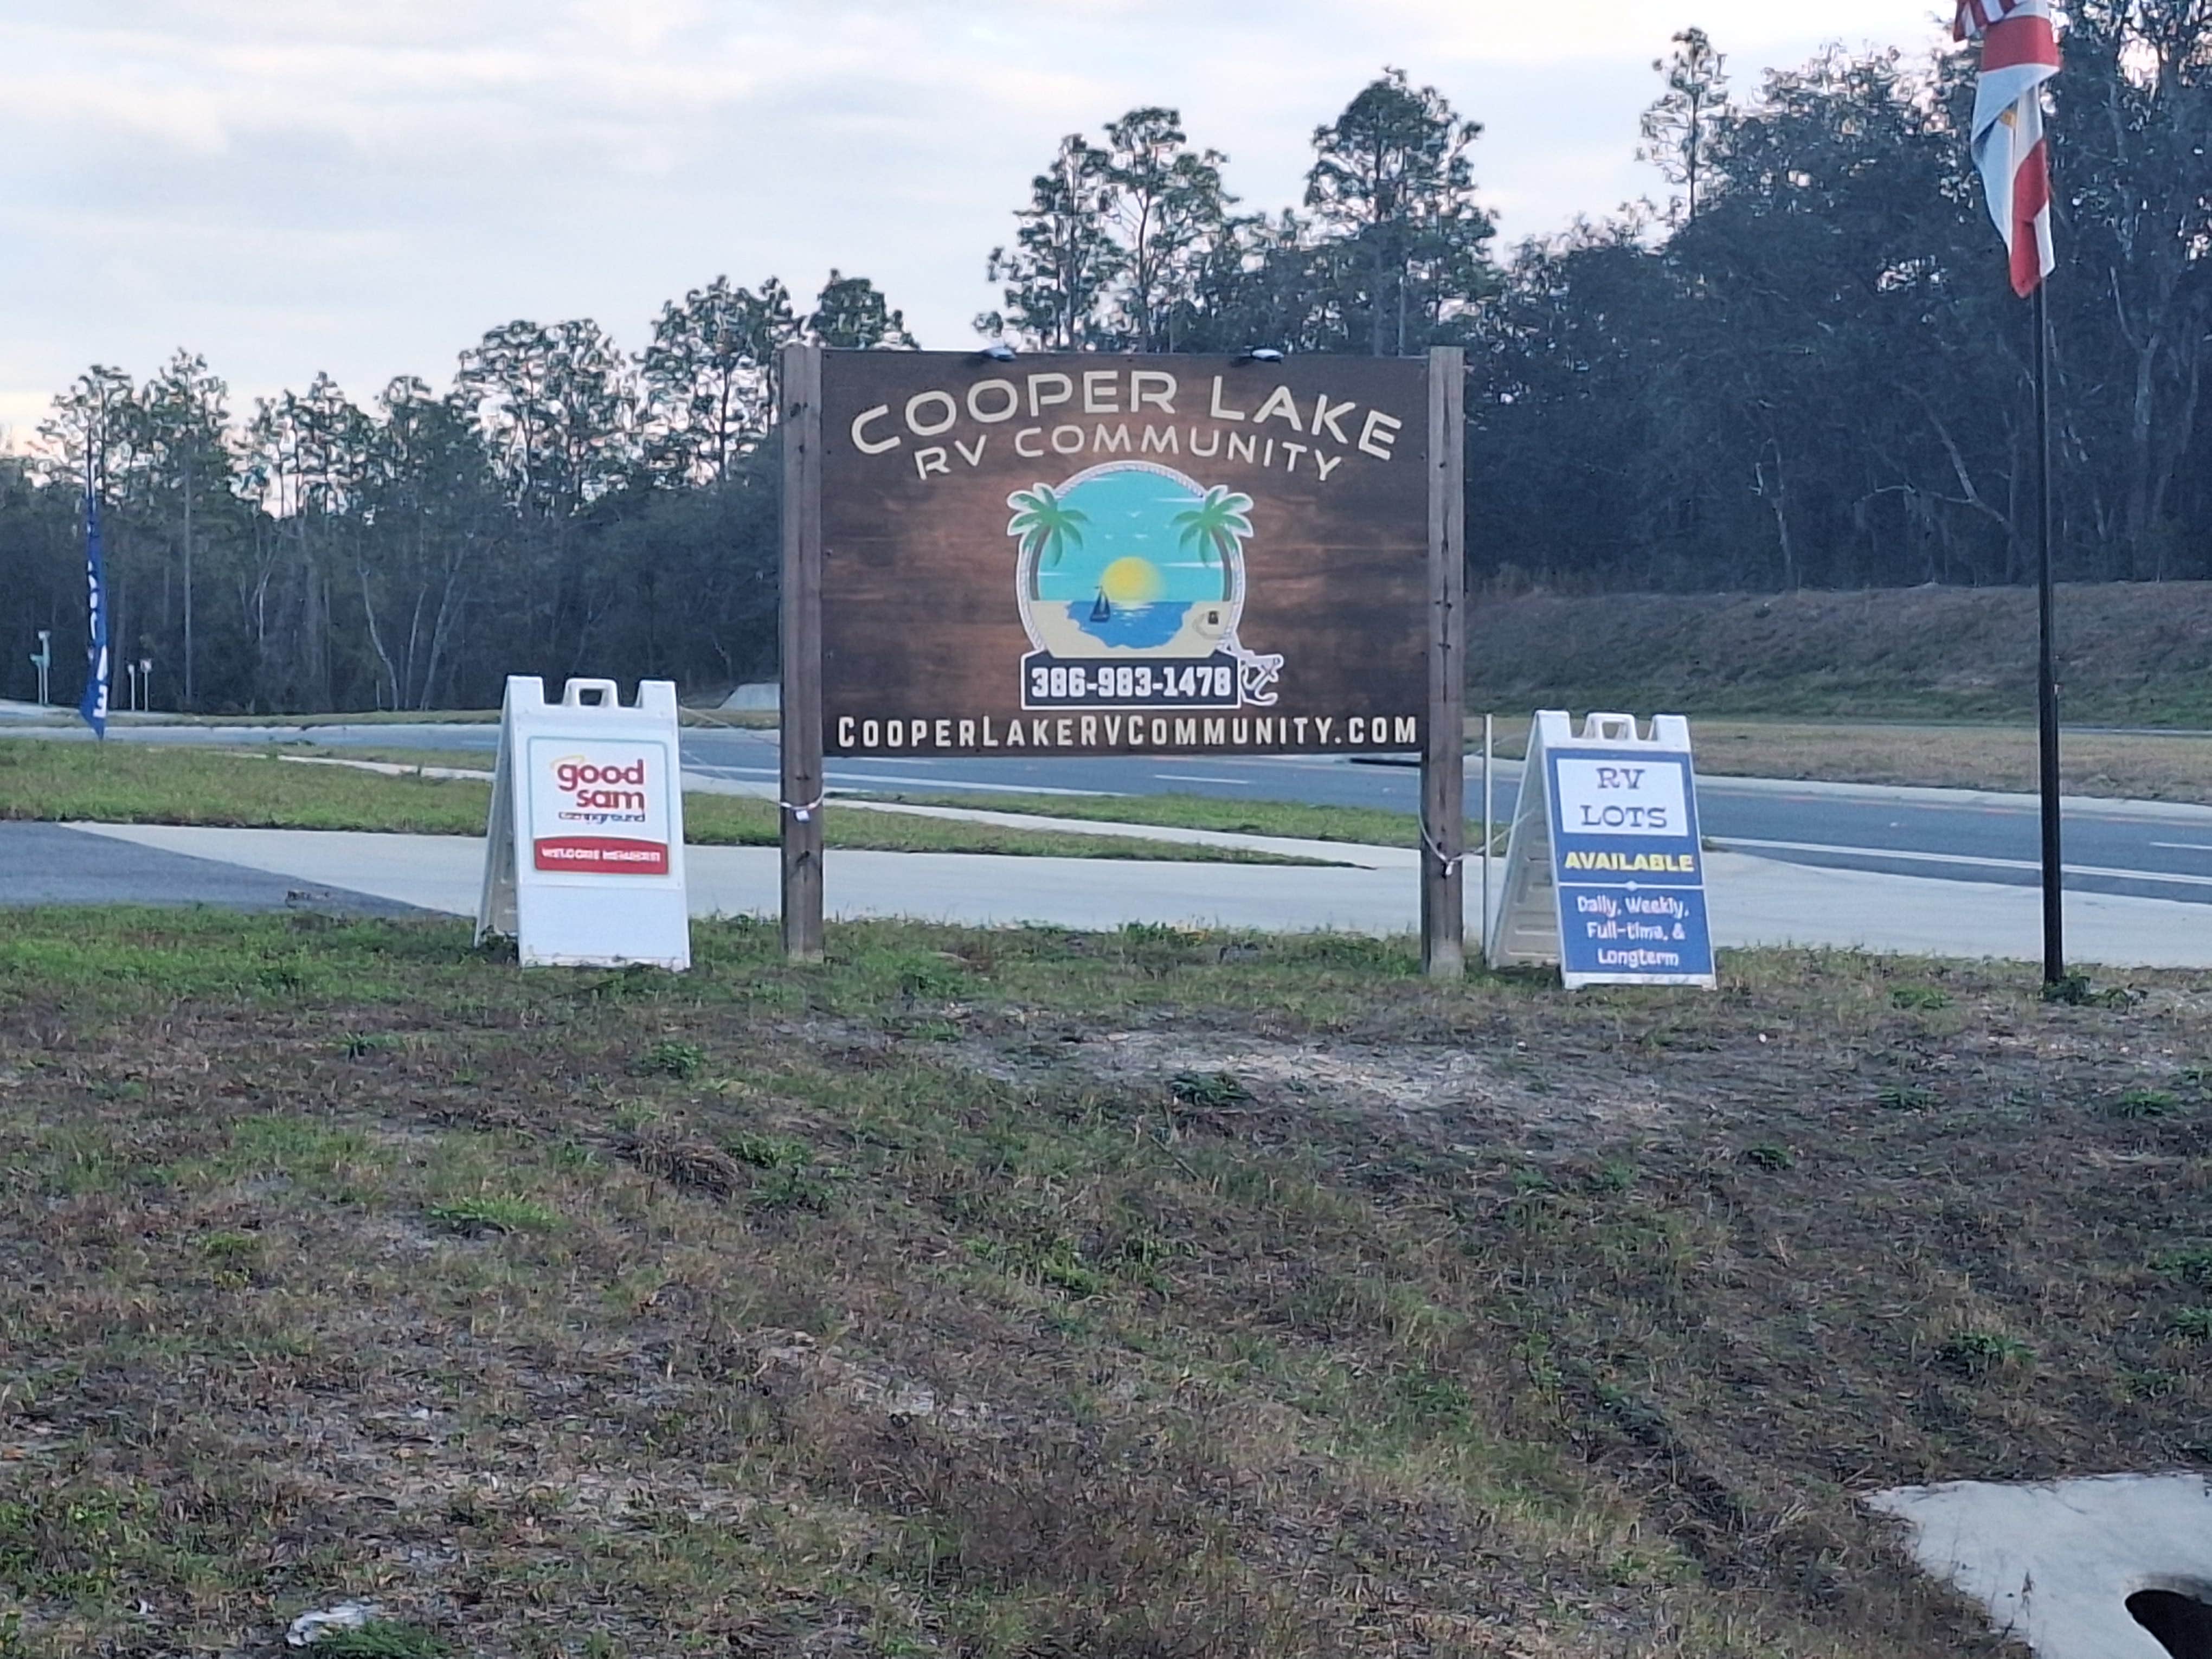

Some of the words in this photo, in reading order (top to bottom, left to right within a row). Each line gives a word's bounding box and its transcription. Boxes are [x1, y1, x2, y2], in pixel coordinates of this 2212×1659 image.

[851, 370, 1178, 454] COOPER
[1210, 375, 1403, 461] LAKE
[914, 435, 987, 480] RV
[1014, 423, 1342, 481] COMMUNITY
[1031, 666, 1231, 697] 386-983-1478
[557, 758, 645, 792] good
[1596, 768, 1645, 790] RV
[576, 789, 645, 810] sam
[1580, 805, 1667, 829] LOTS
[1564, 851, 1695, 872] AVAILABLE
[1577, 895, 1622, 917] Daily,
[1625, 896, 1689, 919] Weekly,
[1586, 922, 1669, 942] Full-time,
[1672, 923, 1686, 940] &
[1597, 948, 1679, 968] Longterm
